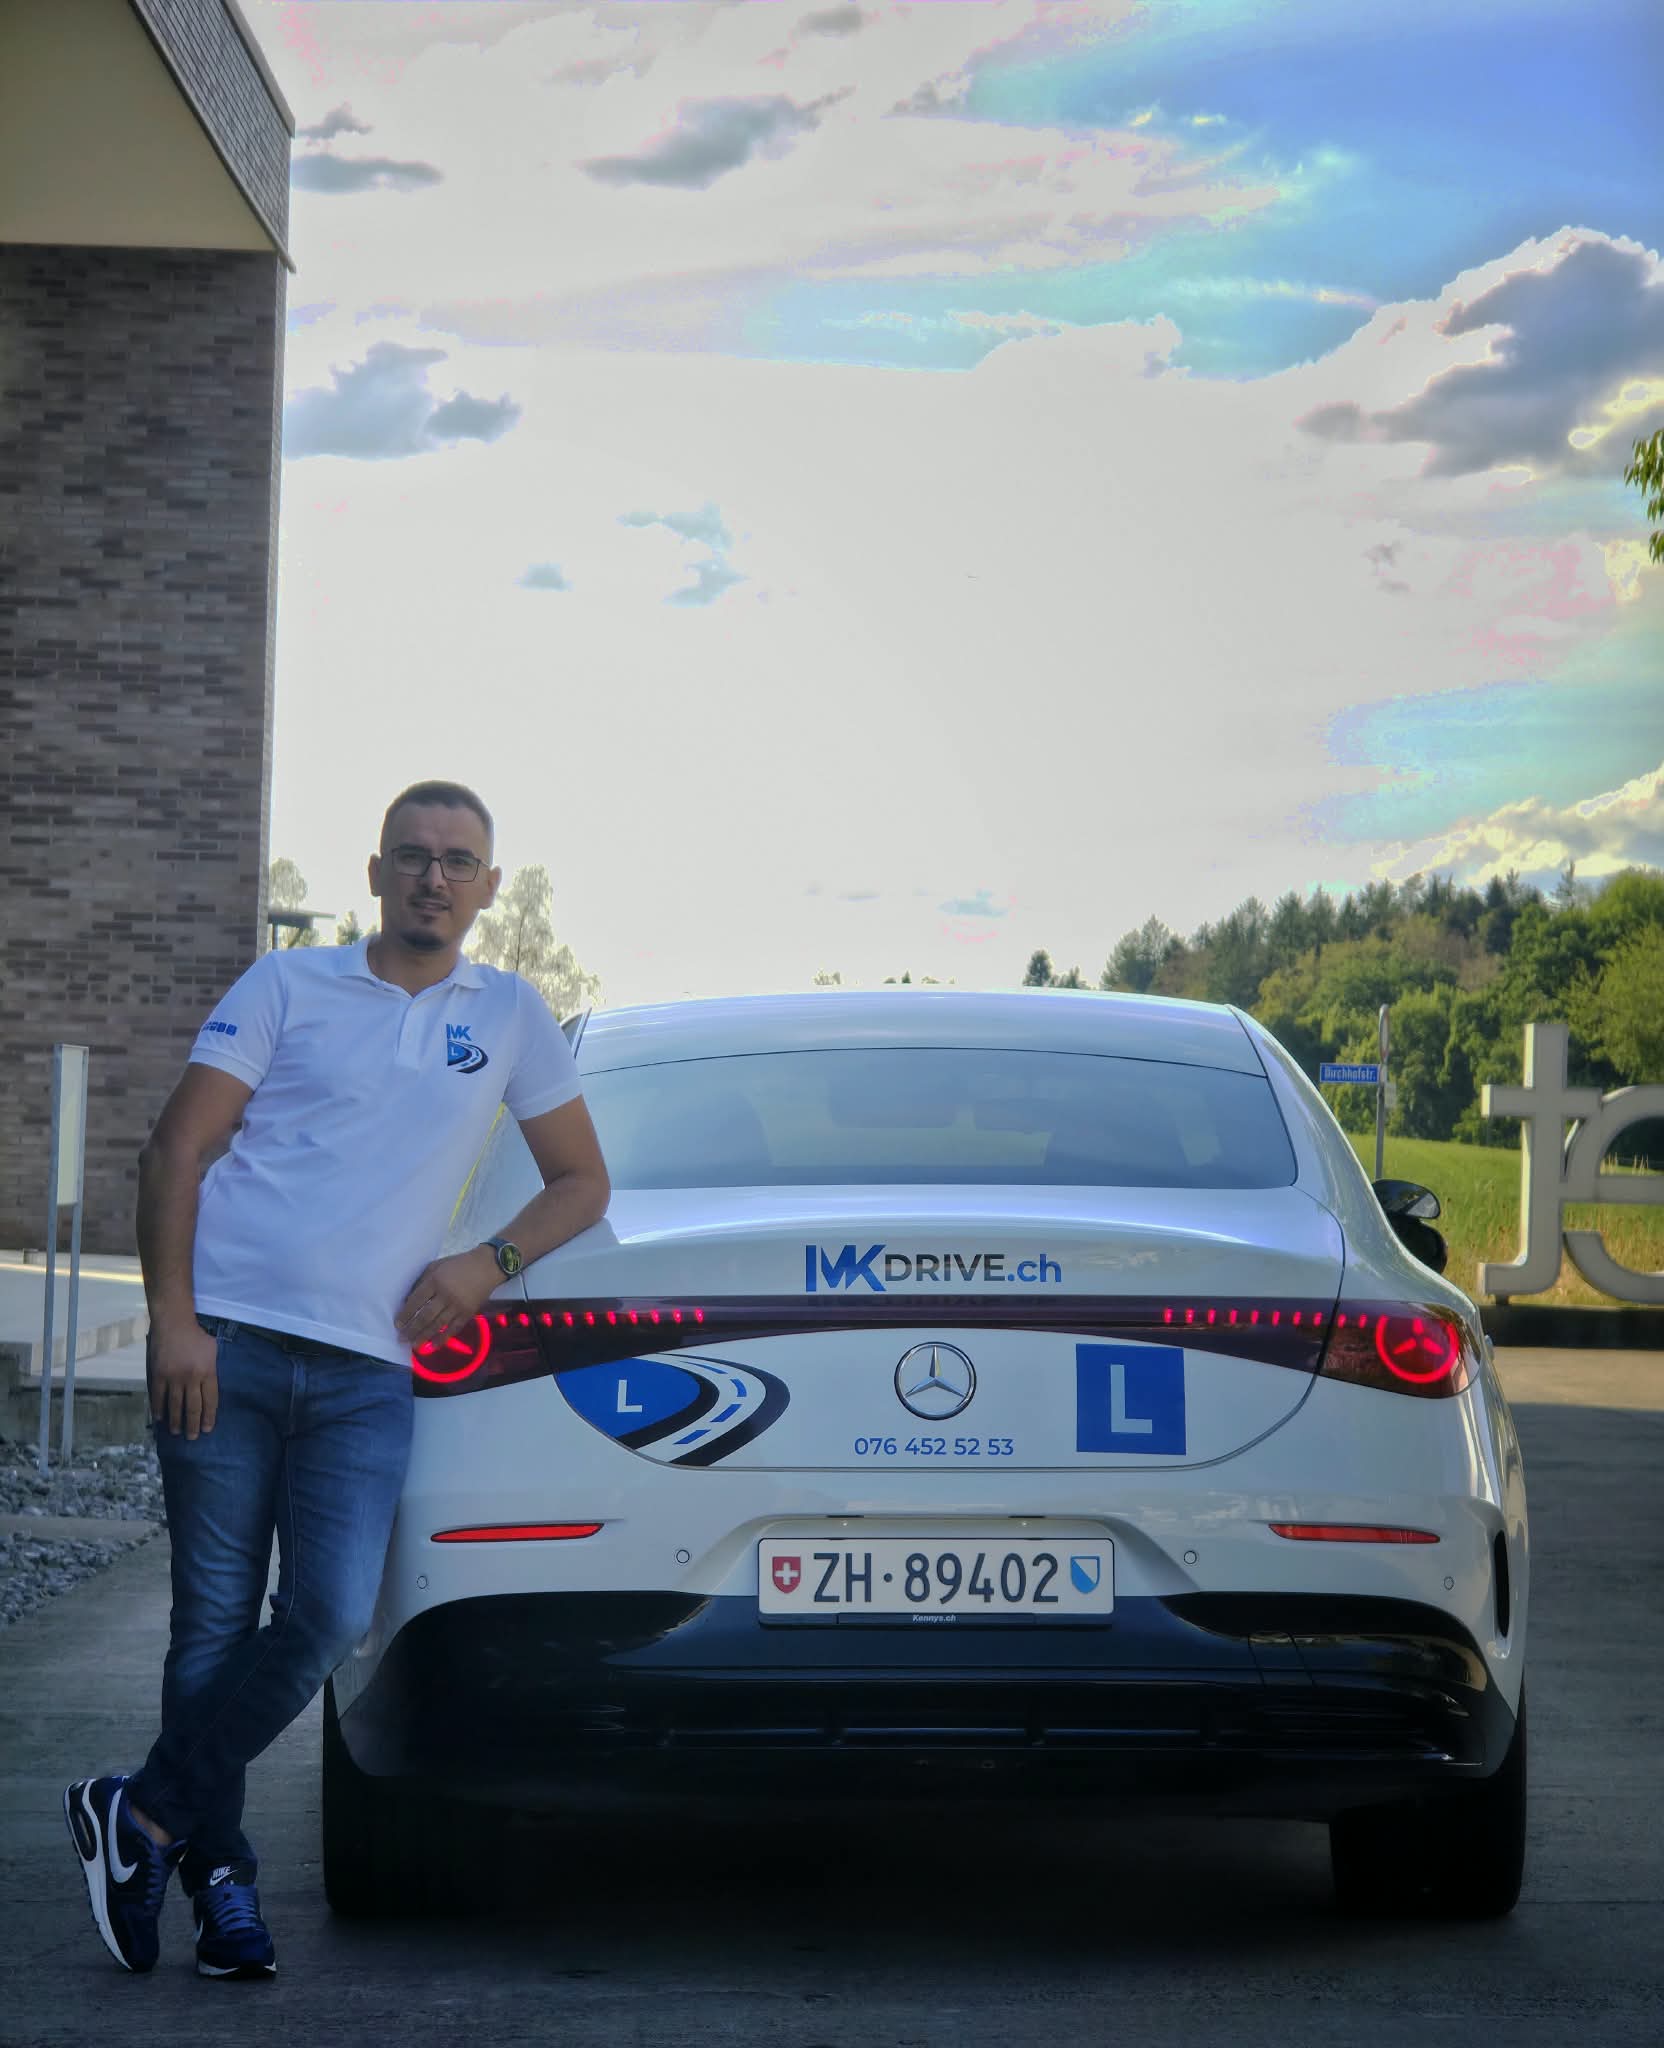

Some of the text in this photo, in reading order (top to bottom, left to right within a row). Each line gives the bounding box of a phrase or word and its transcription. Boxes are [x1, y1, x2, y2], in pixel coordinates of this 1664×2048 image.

[446, 1024, 472, 1041] MK
[616, 1379, 643, 1413] L
[1110, 1364, 1153, 1434] L
[854, 1437, 1014, 1456] 076 452 52 53
